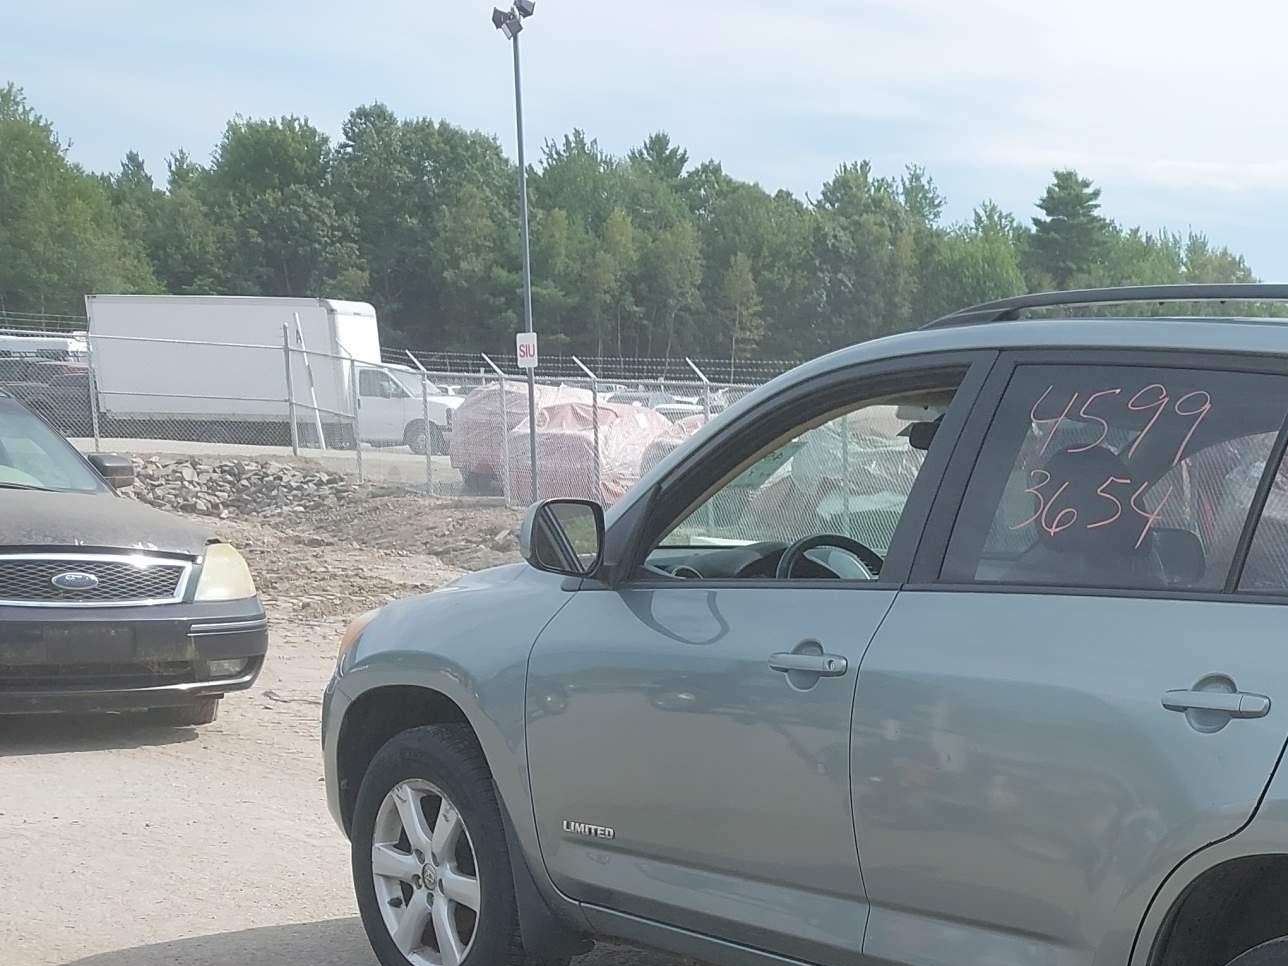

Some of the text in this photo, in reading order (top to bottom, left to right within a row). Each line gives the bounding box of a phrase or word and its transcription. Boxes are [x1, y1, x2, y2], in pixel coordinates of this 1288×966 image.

[519, 344, 535, 358] SIU
[1030, 384, 1212, 466] 4599
[1009, 469, 1173, 549] 3654
[563, 820, 615, 839] LIMITED
